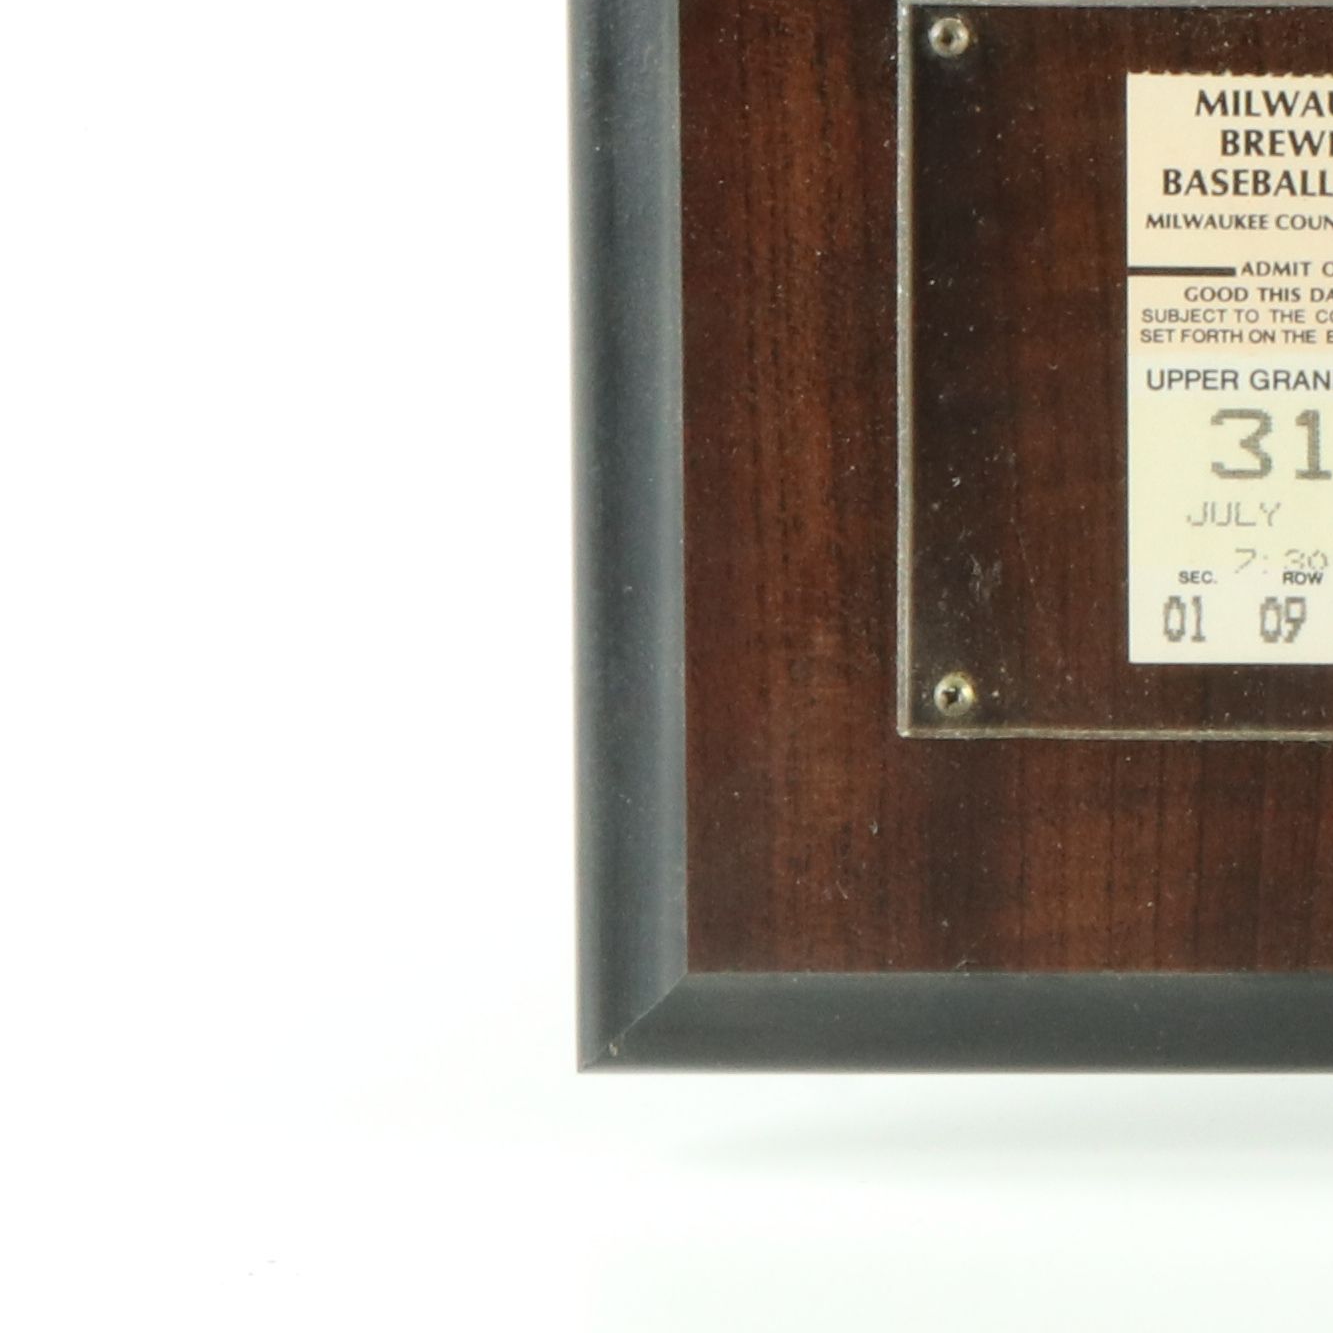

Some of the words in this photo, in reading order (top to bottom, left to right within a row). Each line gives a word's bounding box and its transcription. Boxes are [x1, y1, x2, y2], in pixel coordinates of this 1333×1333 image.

[1145, 214, 1269, 230] MILWAUKEE
[1241, 261, 1312, 277] ADMIT
[1184, 287, 1249, 302] GOOD
[1257, 287, 1300, 302] THIS
[1142, 309, 1227, 324] SUBJECT
[1235, 309, 1259, 324] TO
[1272, 309, 1305, 324] THE
[1140, 329, 1175, 344] SET
[1180, 329, 1243, 344] FORTH
[1249, 329, 1276, 344] ON
[1281, 329, 1317, 344] THE
[1147, 370, 1239, 391] UPPER
[1210, 408, 1332, 480] 31
[1186, 502, 1281, 527] JULY
[1235, 548, 1328, 573] 7:30
[1178, 571, 1217, 585] SEC.
[1282, 571, 1323, 586] ROW
[1163, 595, 1207, 643] 01
[1260, 596, 1307, 644] 09
